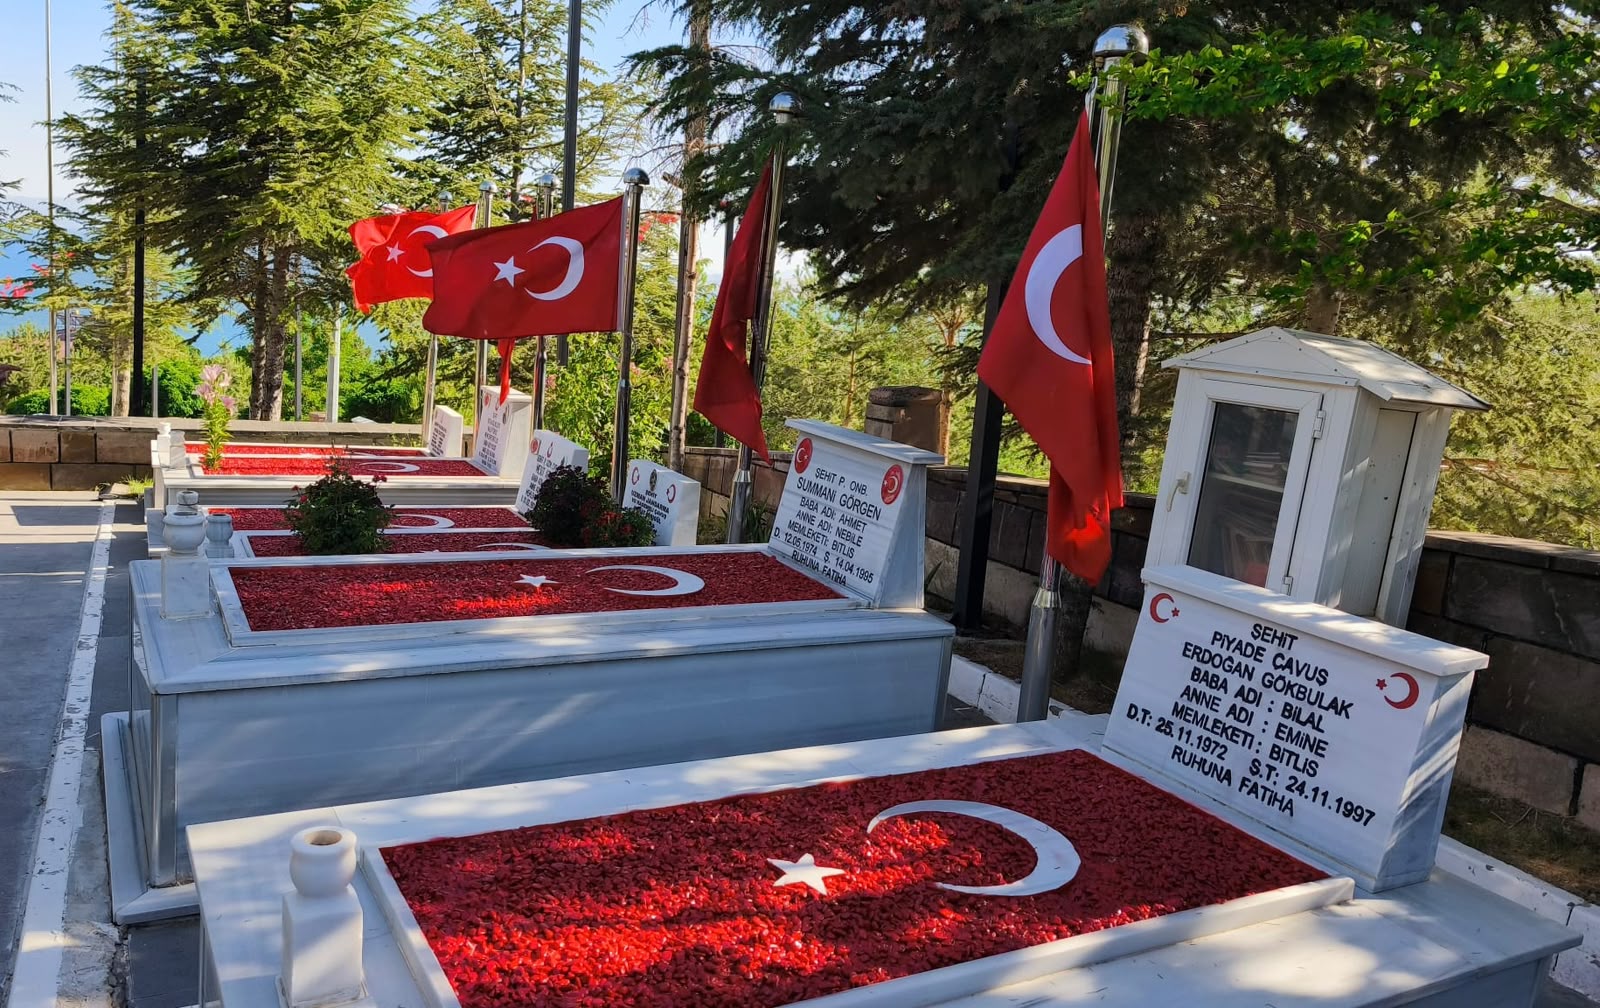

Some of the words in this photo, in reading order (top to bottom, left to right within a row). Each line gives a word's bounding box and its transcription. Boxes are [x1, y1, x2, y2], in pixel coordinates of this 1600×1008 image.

[838, 476, 846, 488] P.
[849, 480, 868, 496] ONB.
[799, 496, 818, 513] BABA
[838, 513, 868, 533] AHMET
[839, 493, 882, 521] GÖRGEN
[795, 510, 816, 526] ANNE
[835, 526, 863, 547] NEBİLE
[835, 557, 874, 584] 14.04.1995
[1251, 623, 1298, 650] ŞEHİT
[1210, 631, 1266, 662] PİYADE
[1272, 652, 1328, 686] ÇAVUŞ
[1182, 641, 1255, 681] ERDOĞAN
[1261, 672, 1353, 719] GÖKBULAK
[1190, 666, 1228, 694] BABA
[1234, 684, 1263, 707] ADI
[1281, 702, 1325, 733] BİLAL
[1180, 685, 1221, 712] ANNE
[1225, 703, 1254, 727] ADI
[1274, 722, 1329, 758] EMİNE
[1126, 703, 1152, 727] D.T:
[1155, 717, 1228, 761] 25.11.1972
[1285, 775, 1376, 827] 24.11.1997
[1268, 743, 1318, 777] BİTLİS
[1171, 745, 1232, 787] RUHUNA
[1238, 776, 1294, 817] FATİHA
